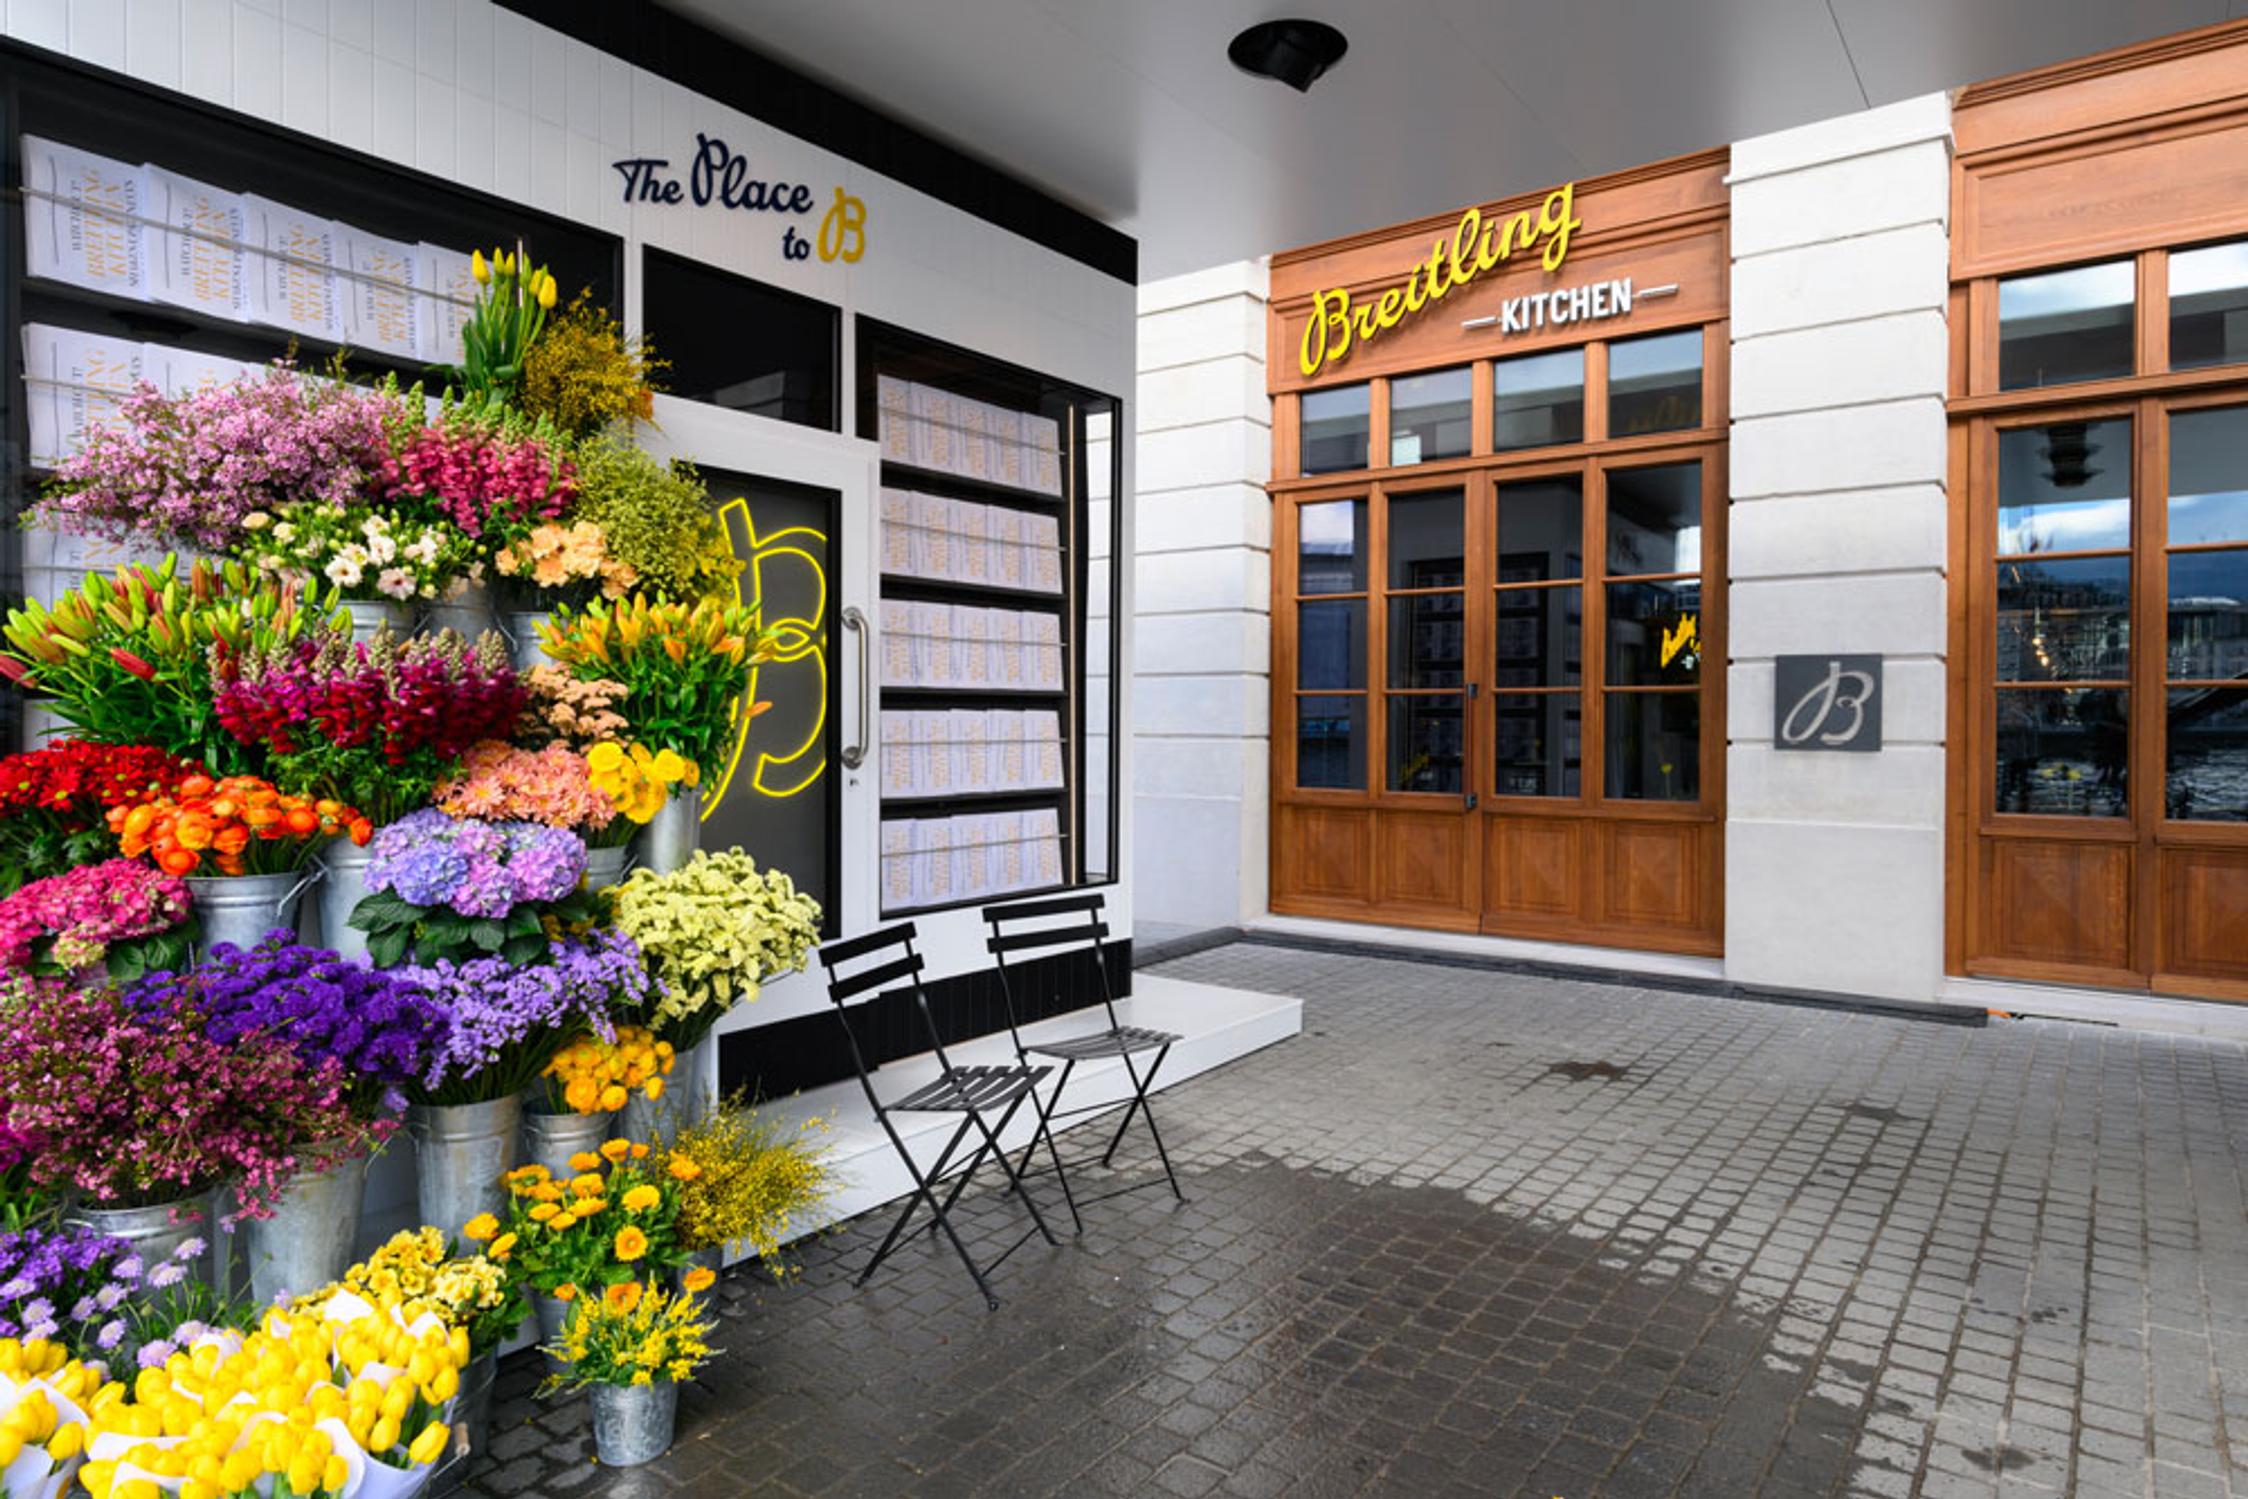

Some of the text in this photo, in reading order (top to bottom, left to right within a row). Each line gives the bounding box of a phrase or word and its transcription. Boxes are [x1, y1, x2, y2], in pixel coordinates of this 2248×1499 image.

[612, 133, 815, 214] The Place
[782, 186, 868, 264] to B
[1298, 183, 1582, 376] Breitling
[1501, 277, 1634, 334] KITCHEN
[1782, 661, 1874, 745] B
